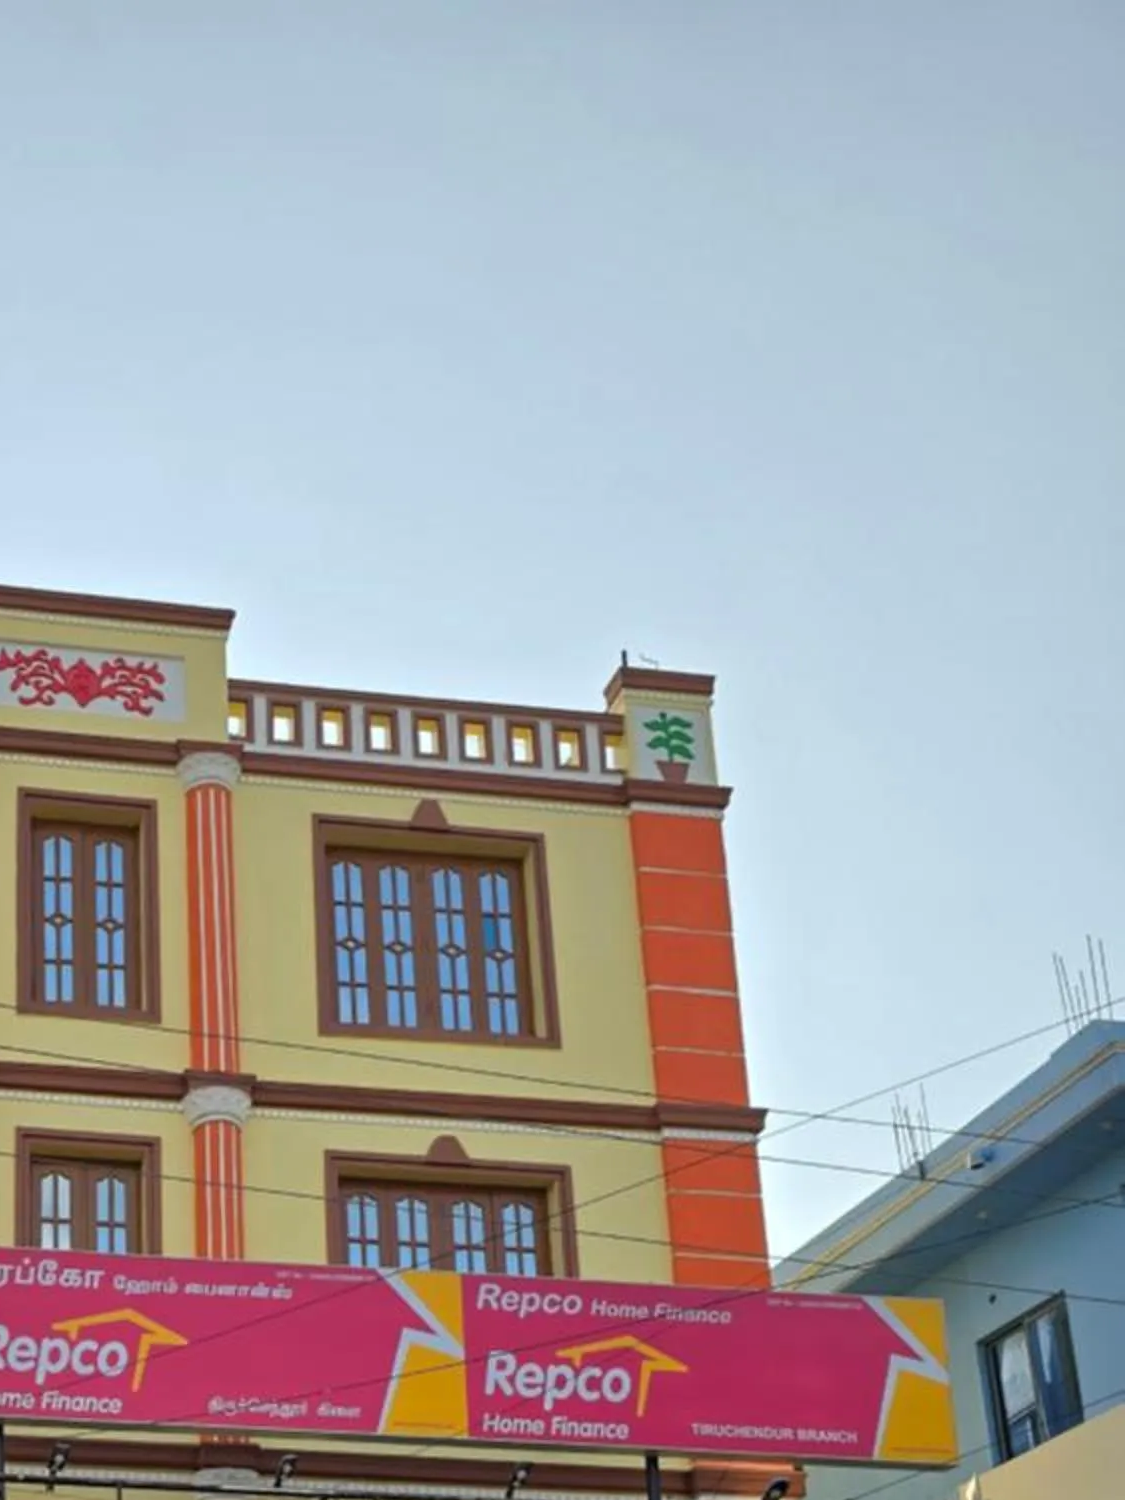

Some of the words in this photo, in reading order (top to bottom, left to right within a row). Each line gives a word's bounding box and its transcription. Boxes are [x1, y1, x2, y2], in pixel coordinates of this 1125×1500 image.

[476, 1283, 583, 1319] Repco
[590, 1299, 649, 1319] Home
[653, 1302, 733, 1325] Finance
[484, 1350, 632, 1412] Repco
[40, 1390, 123, 1414] Finance
[481, 1413, 545, 1436] Home
[550, 1416, 630, 1440] Finance
[691, 1423, 794, 1441] TIRUCHENDUR
[797, 1427, 858, 1444] BRANCH
